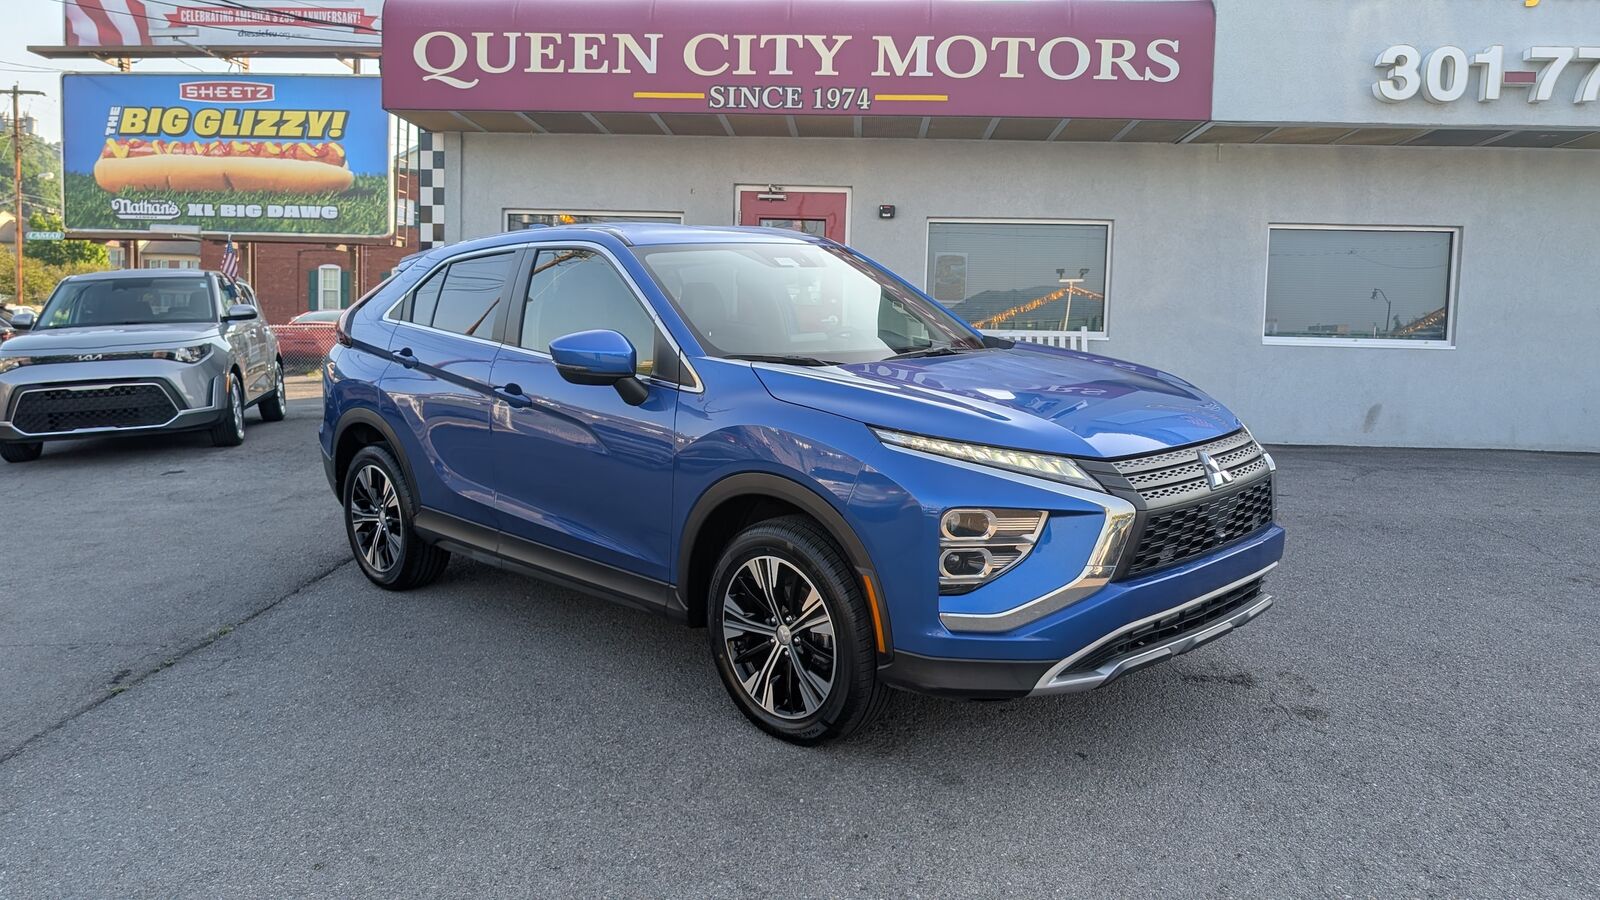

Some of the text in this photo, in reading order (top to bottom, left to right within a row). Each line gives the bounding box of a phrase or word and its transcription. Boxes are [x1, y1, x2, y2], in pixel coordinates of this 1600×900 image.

[180, 9, 233, 23] CELEBRATING
[302, 10, 361, 23] ANNIVERSARY!
[412, 31, 1181, 89] QUEEN CITY MOTORS
[186, 86, 268, 98] SHEETZ
[708, 85, 871, 110] SINCE 1974
[104, 106, 121, 136] THE
[118, 106, 349, 139] BIG GLIZZY!
[111, 198, 180, 217] Nathan's
[187, 203, 338, 219] XL BIG DAWG
